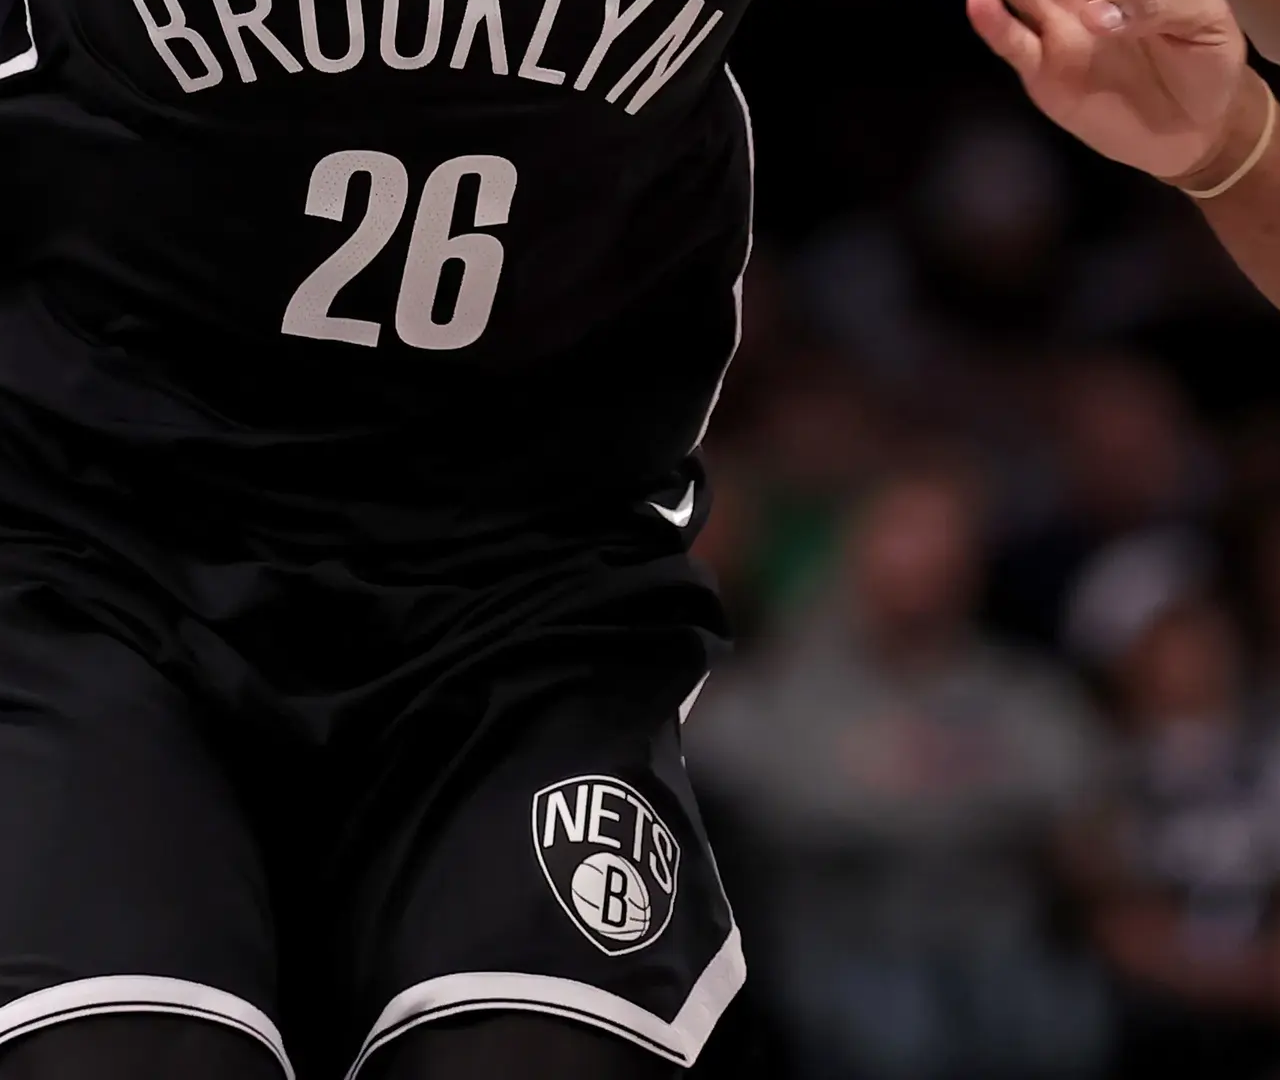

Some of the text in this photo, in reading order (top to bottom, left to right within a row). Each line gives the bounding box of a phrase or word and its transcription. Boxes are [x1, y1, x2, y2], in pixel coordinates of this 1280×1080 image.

[280, 149, 519, 351] 26
[543, 784, 672, 895] NETS
[601, 863, 628, 928] B
